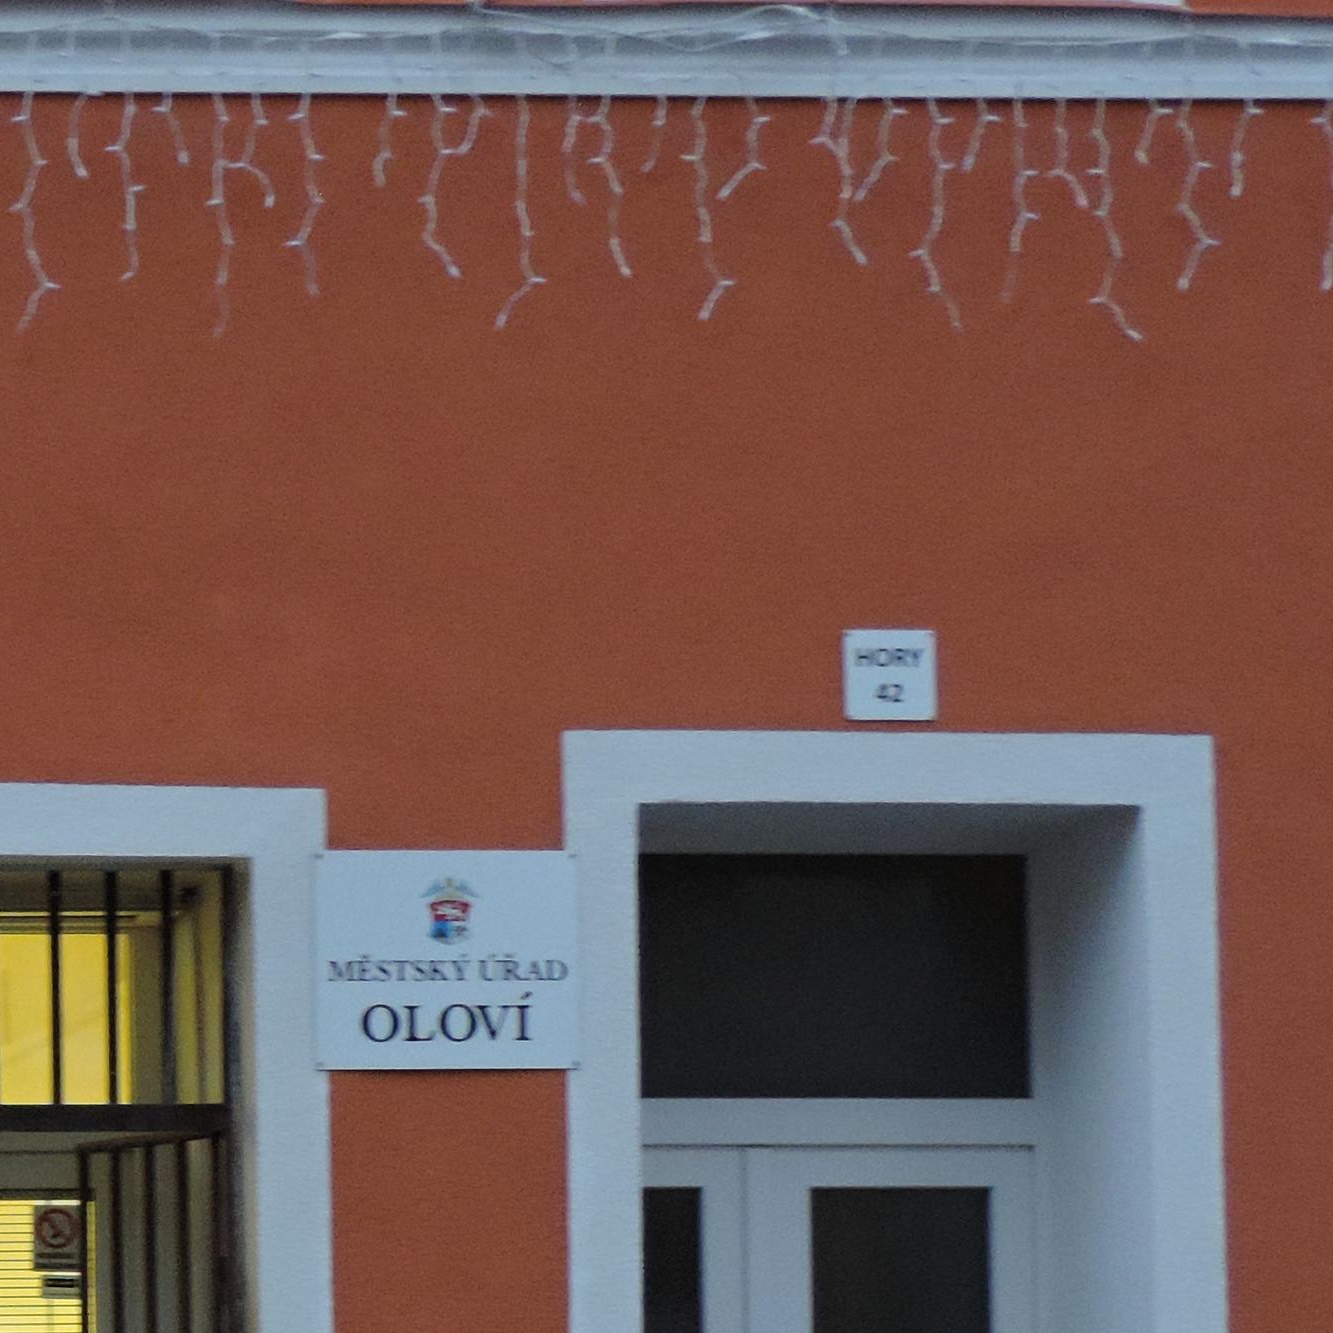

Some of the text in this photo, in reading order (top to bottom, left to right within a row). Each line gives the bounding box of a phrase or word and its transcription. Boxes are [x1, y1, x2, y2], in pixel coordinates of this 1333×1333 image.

[854, 648, 924, 667] HORY
[875, 683, 904, 702] 42
[327, 953, 569, 981] MĚSTSKÝ ÚŘAD
[361, 991, 534, 1042] OLOVÍ
